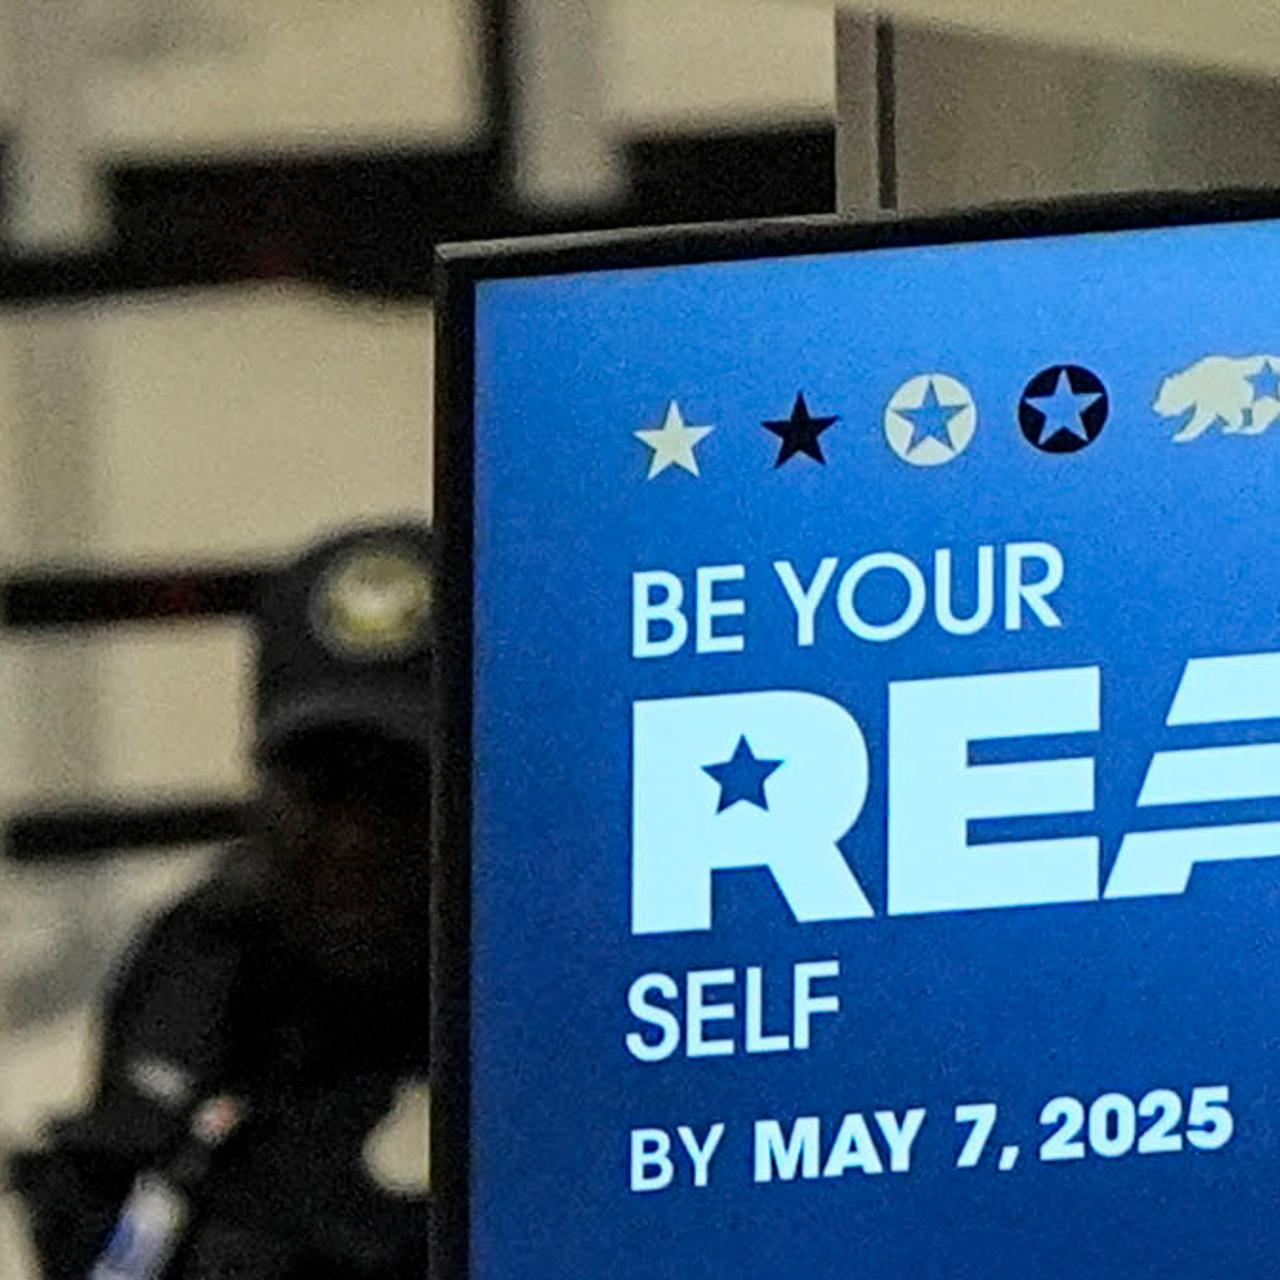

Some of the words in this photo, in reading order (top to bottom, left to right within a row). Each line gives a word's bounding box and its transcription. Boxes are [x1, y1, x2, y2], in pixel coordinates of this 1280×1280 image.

[632, 564, 746, 658] BE
[773, 541, 1064, 646] YOUR
[625, 960, 840, 1061] SELF
[630, 1122, 725, 1192] BY
[754, 1108, 926, 1183] MAY
[954, 1102, 1020, 1171] 7,
[1039, 1085, 1234, 1161] 2025
